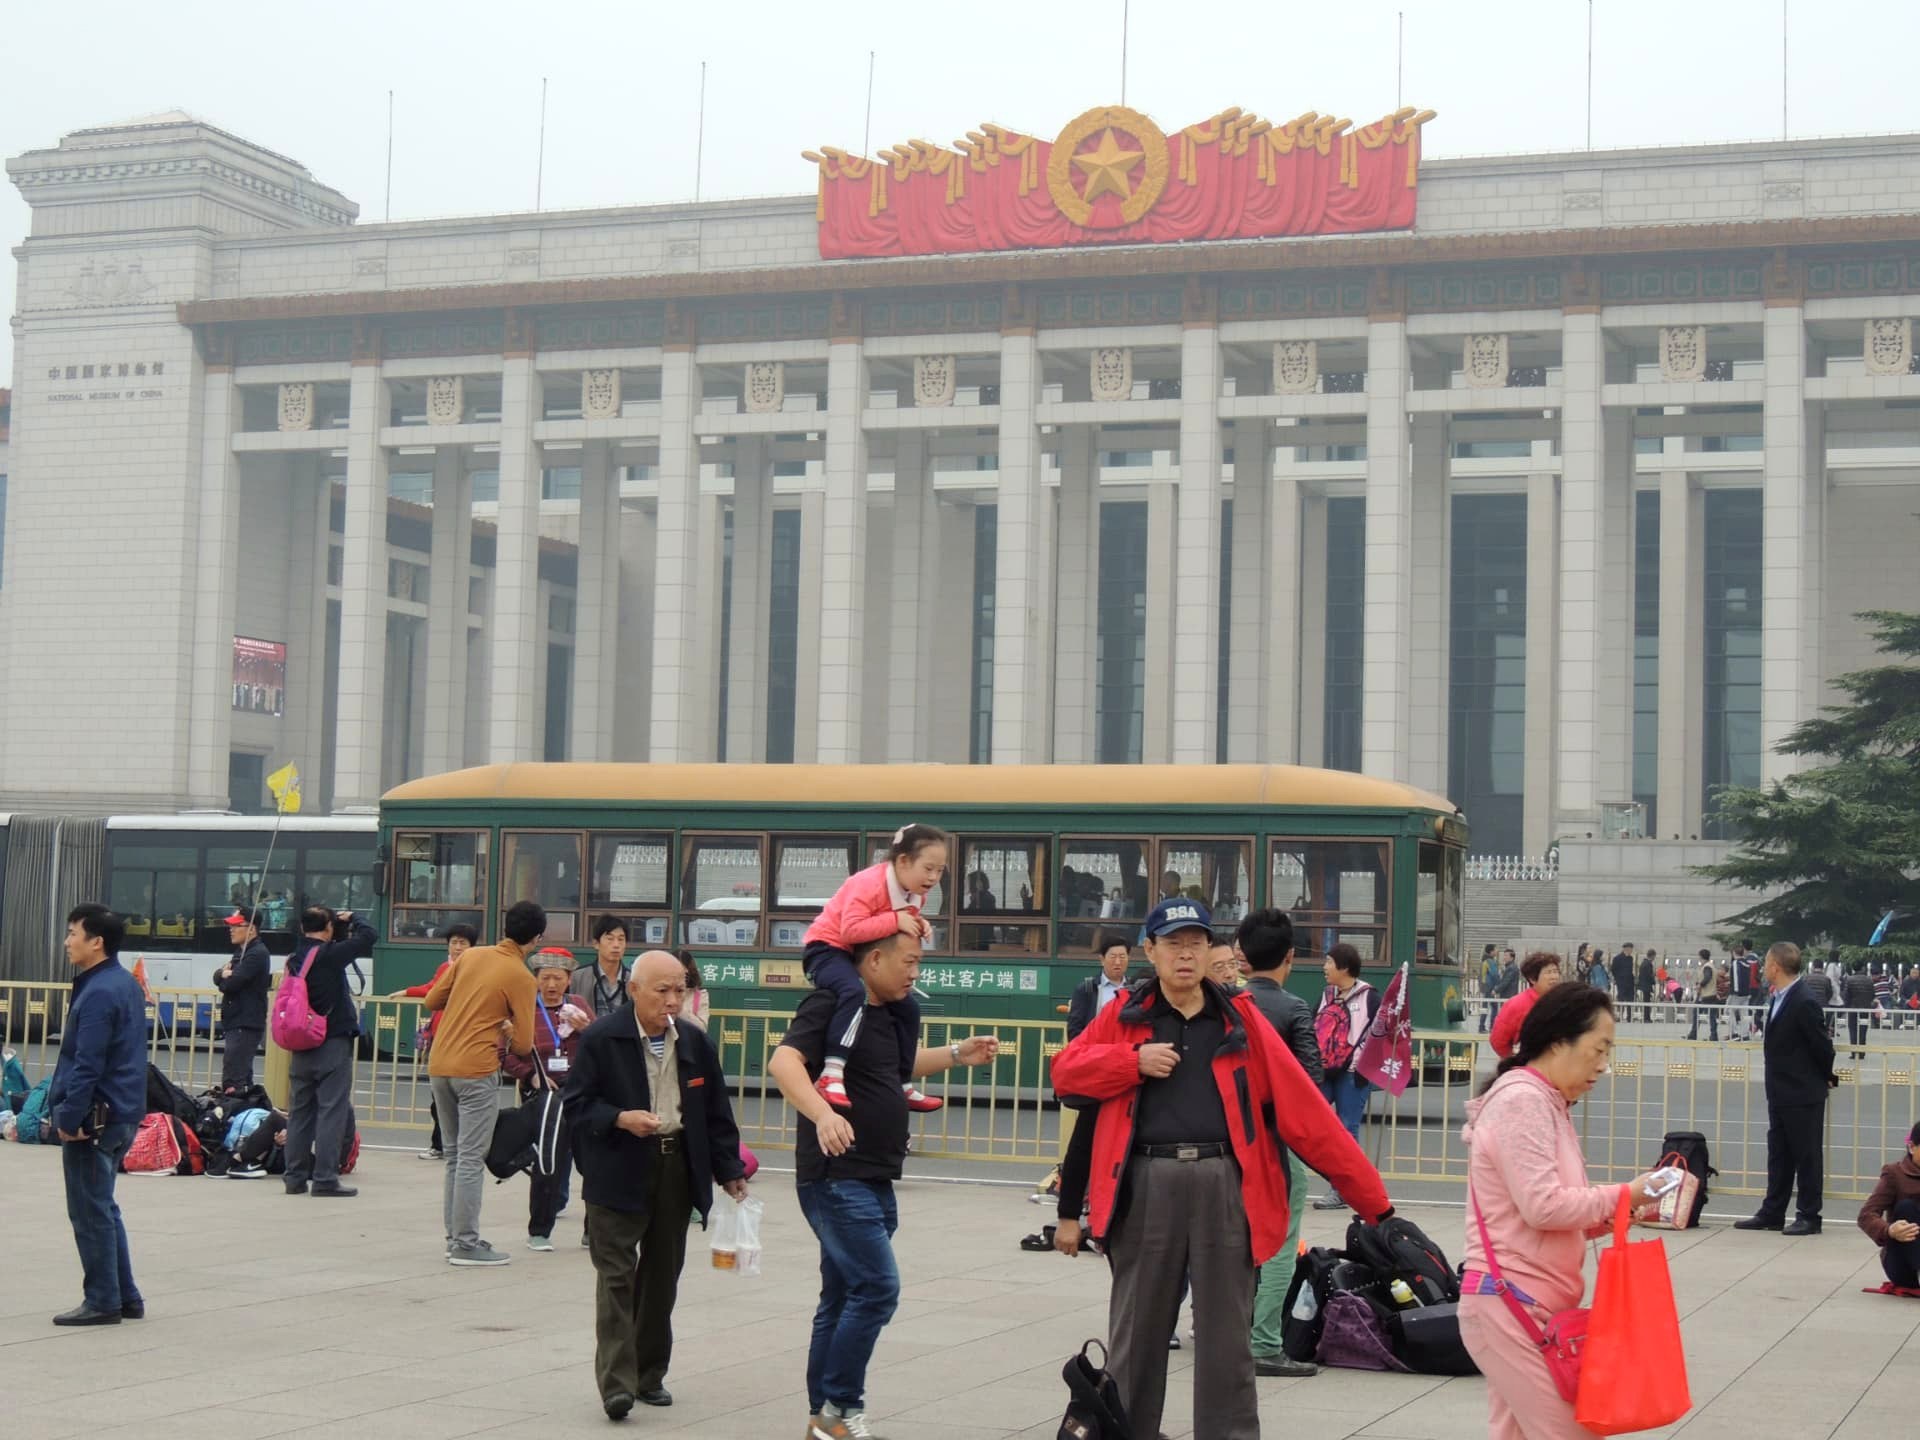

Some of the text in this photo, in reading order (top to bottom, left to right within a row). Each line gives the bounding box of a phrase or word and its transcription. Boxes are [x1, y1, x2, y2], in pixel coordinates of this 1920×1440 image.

[47, 393, 83, 401] NATIONAL
[89, 391, 121, 400] MUSEUM
[140, 390, 163, 398] CHINA
[1165, 905, 1200, 921] BSA
[698, 963, 755, 982] 客户端
[913, 968, 1014, 988] 华社客户端
